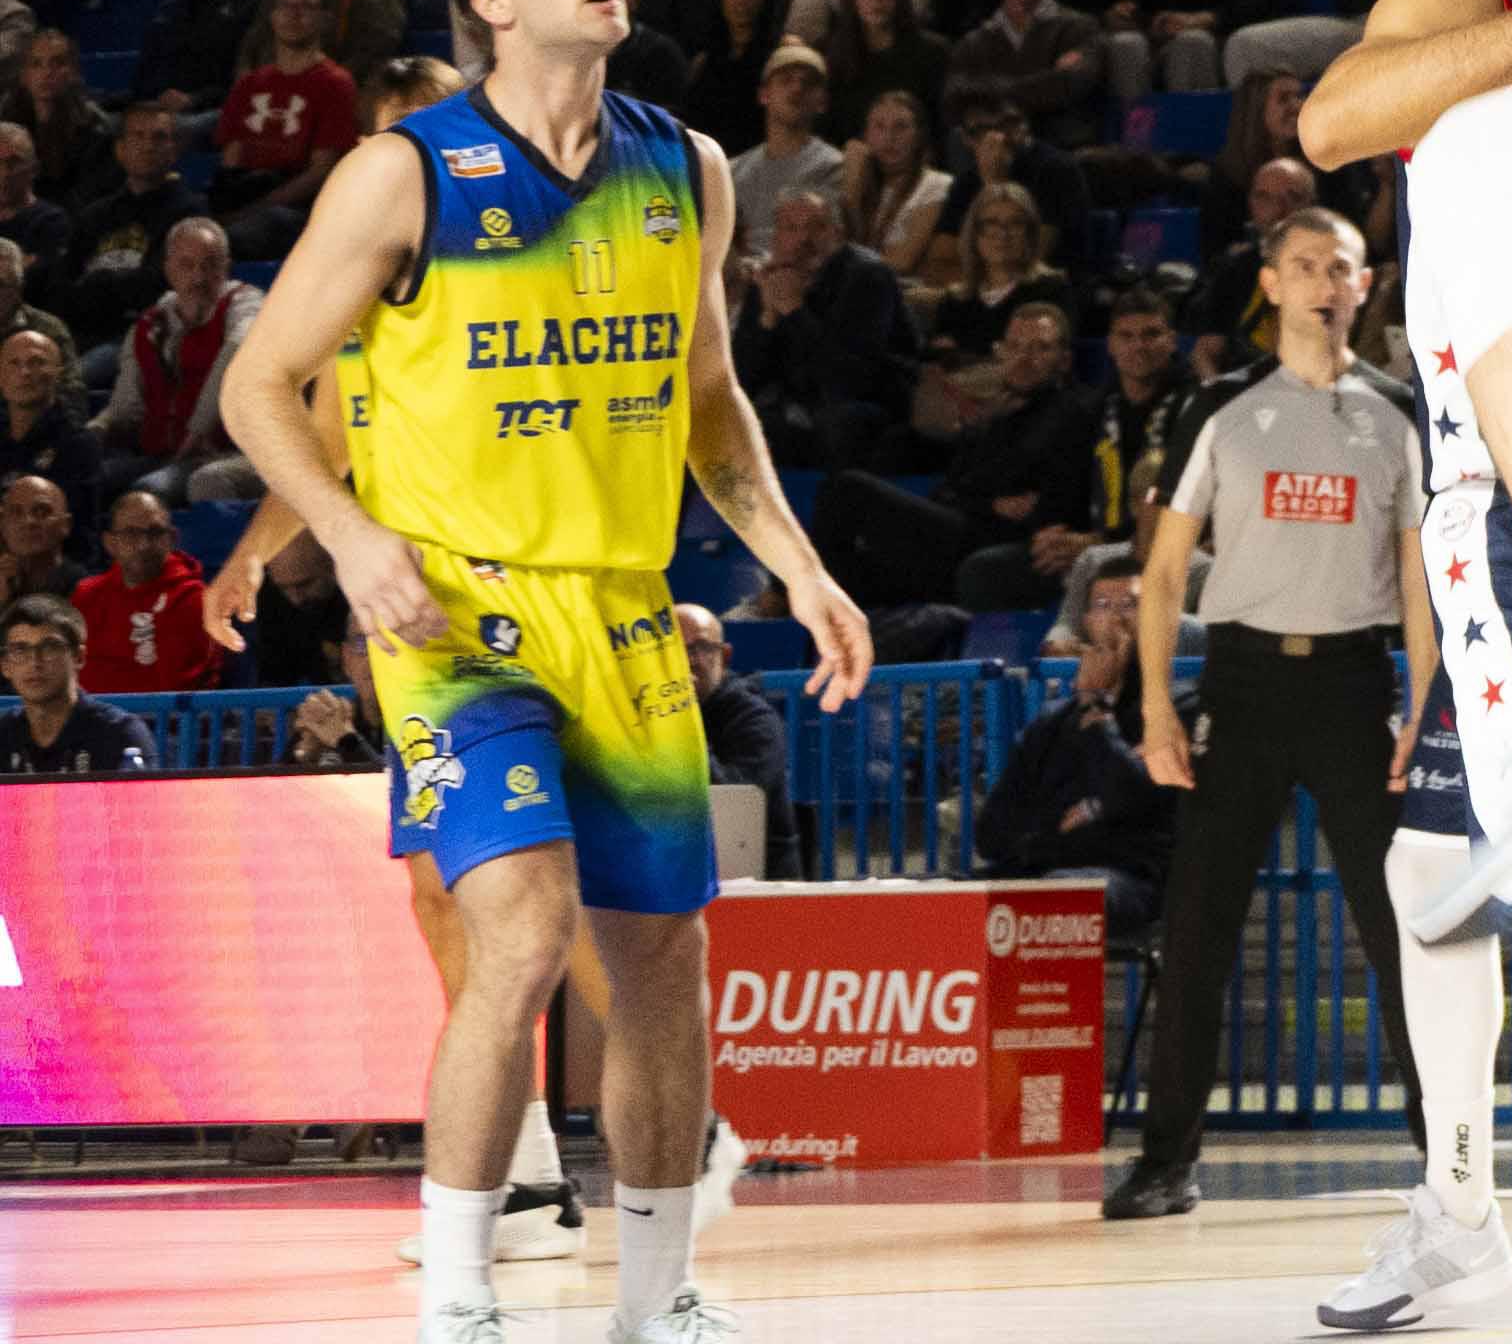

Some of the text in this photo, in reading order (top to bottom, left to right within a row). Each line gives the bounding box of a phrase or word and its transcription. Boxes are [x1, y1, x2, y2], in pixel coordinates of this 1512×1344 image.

[567, 239, 617, 296] 11
[715, 969, 981, 1035] DURING
[715, 1038, 979, 1073] Agenzia per il Lavoro
[1456, 1123, 1471, 1169] CRAFT
